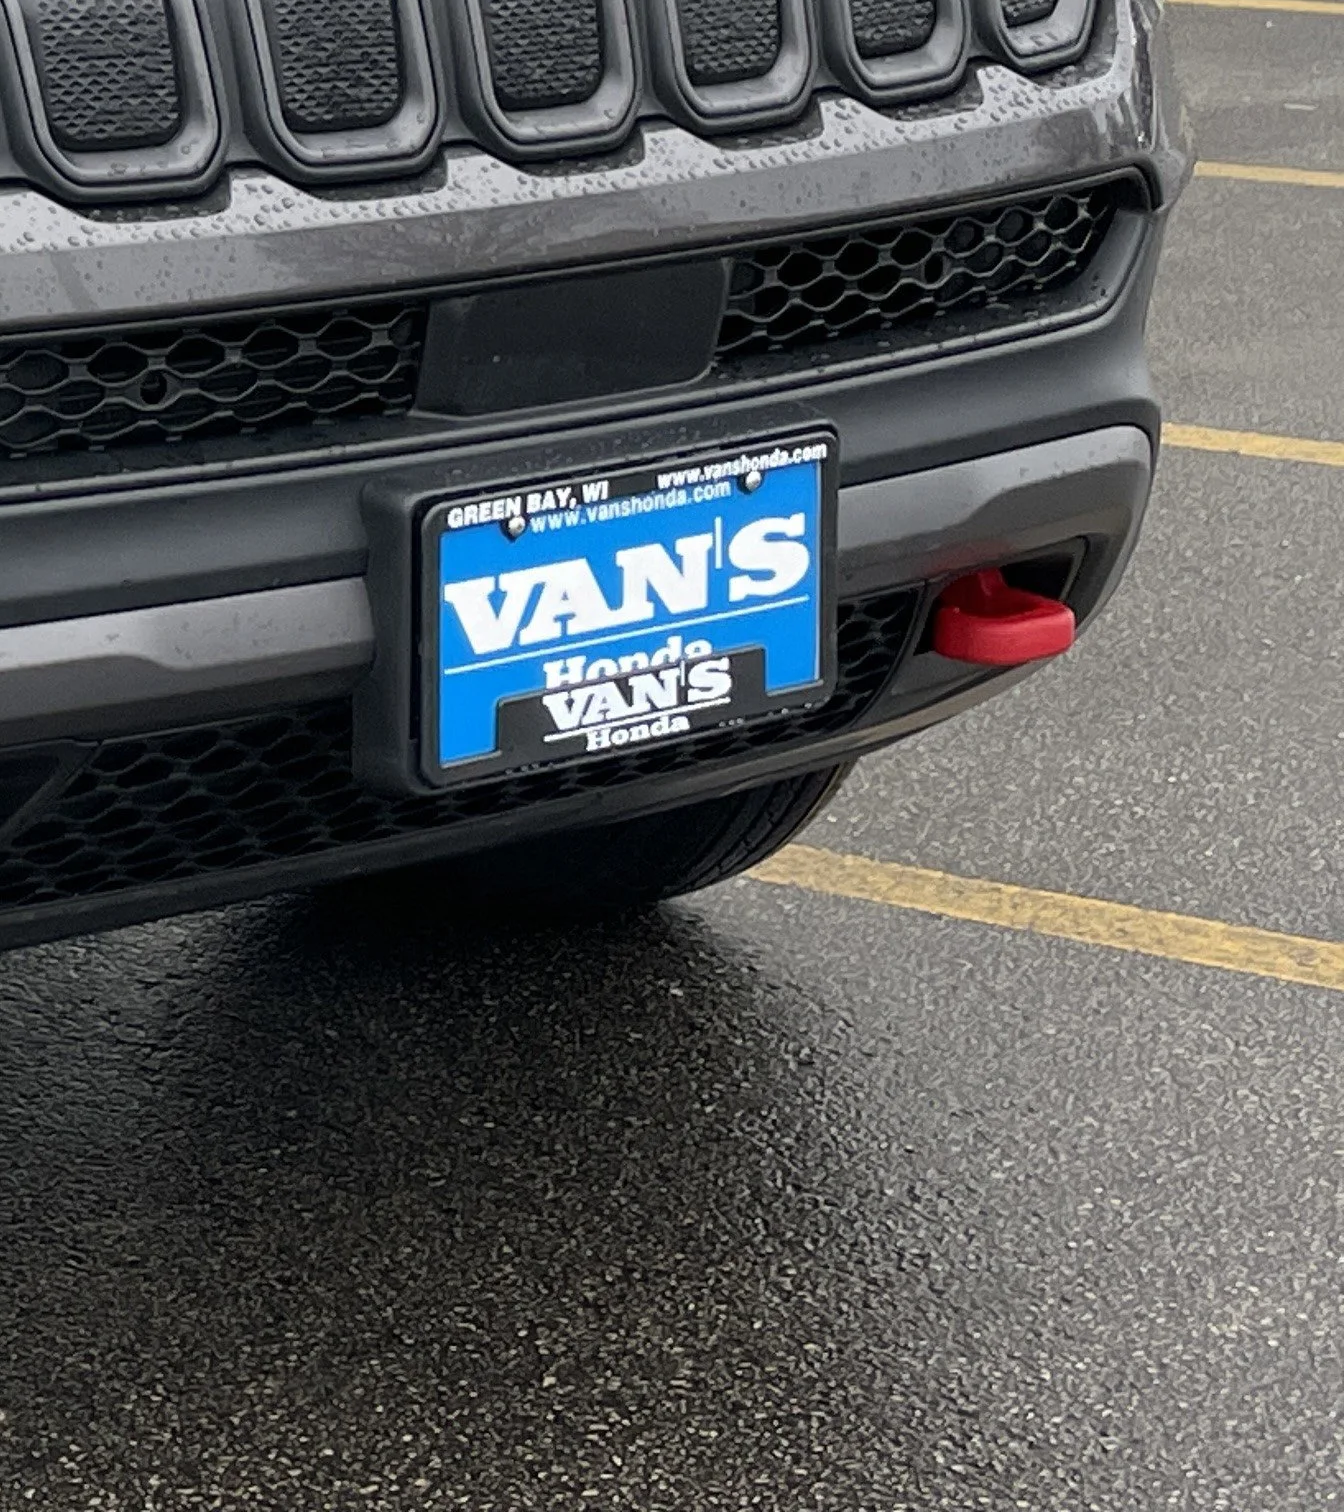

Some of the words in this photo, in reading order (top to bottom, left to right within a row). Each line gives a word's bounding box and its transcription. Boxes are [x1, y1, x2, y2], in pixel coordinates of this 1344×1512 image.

[656, 442, 828, 490] www.vanshonda.com
[446, 494, 523, 529] GREEN
[526, 485, 578, 515] BAY,
[582, 479, 610, 504] WI
[529, 480, 732, 534] www.vanshonda.com
[443, 512, 810, 656] VAN'S
[541, 656, 733, 732] VAN'S
[585, 715, 691, 753] Honda
